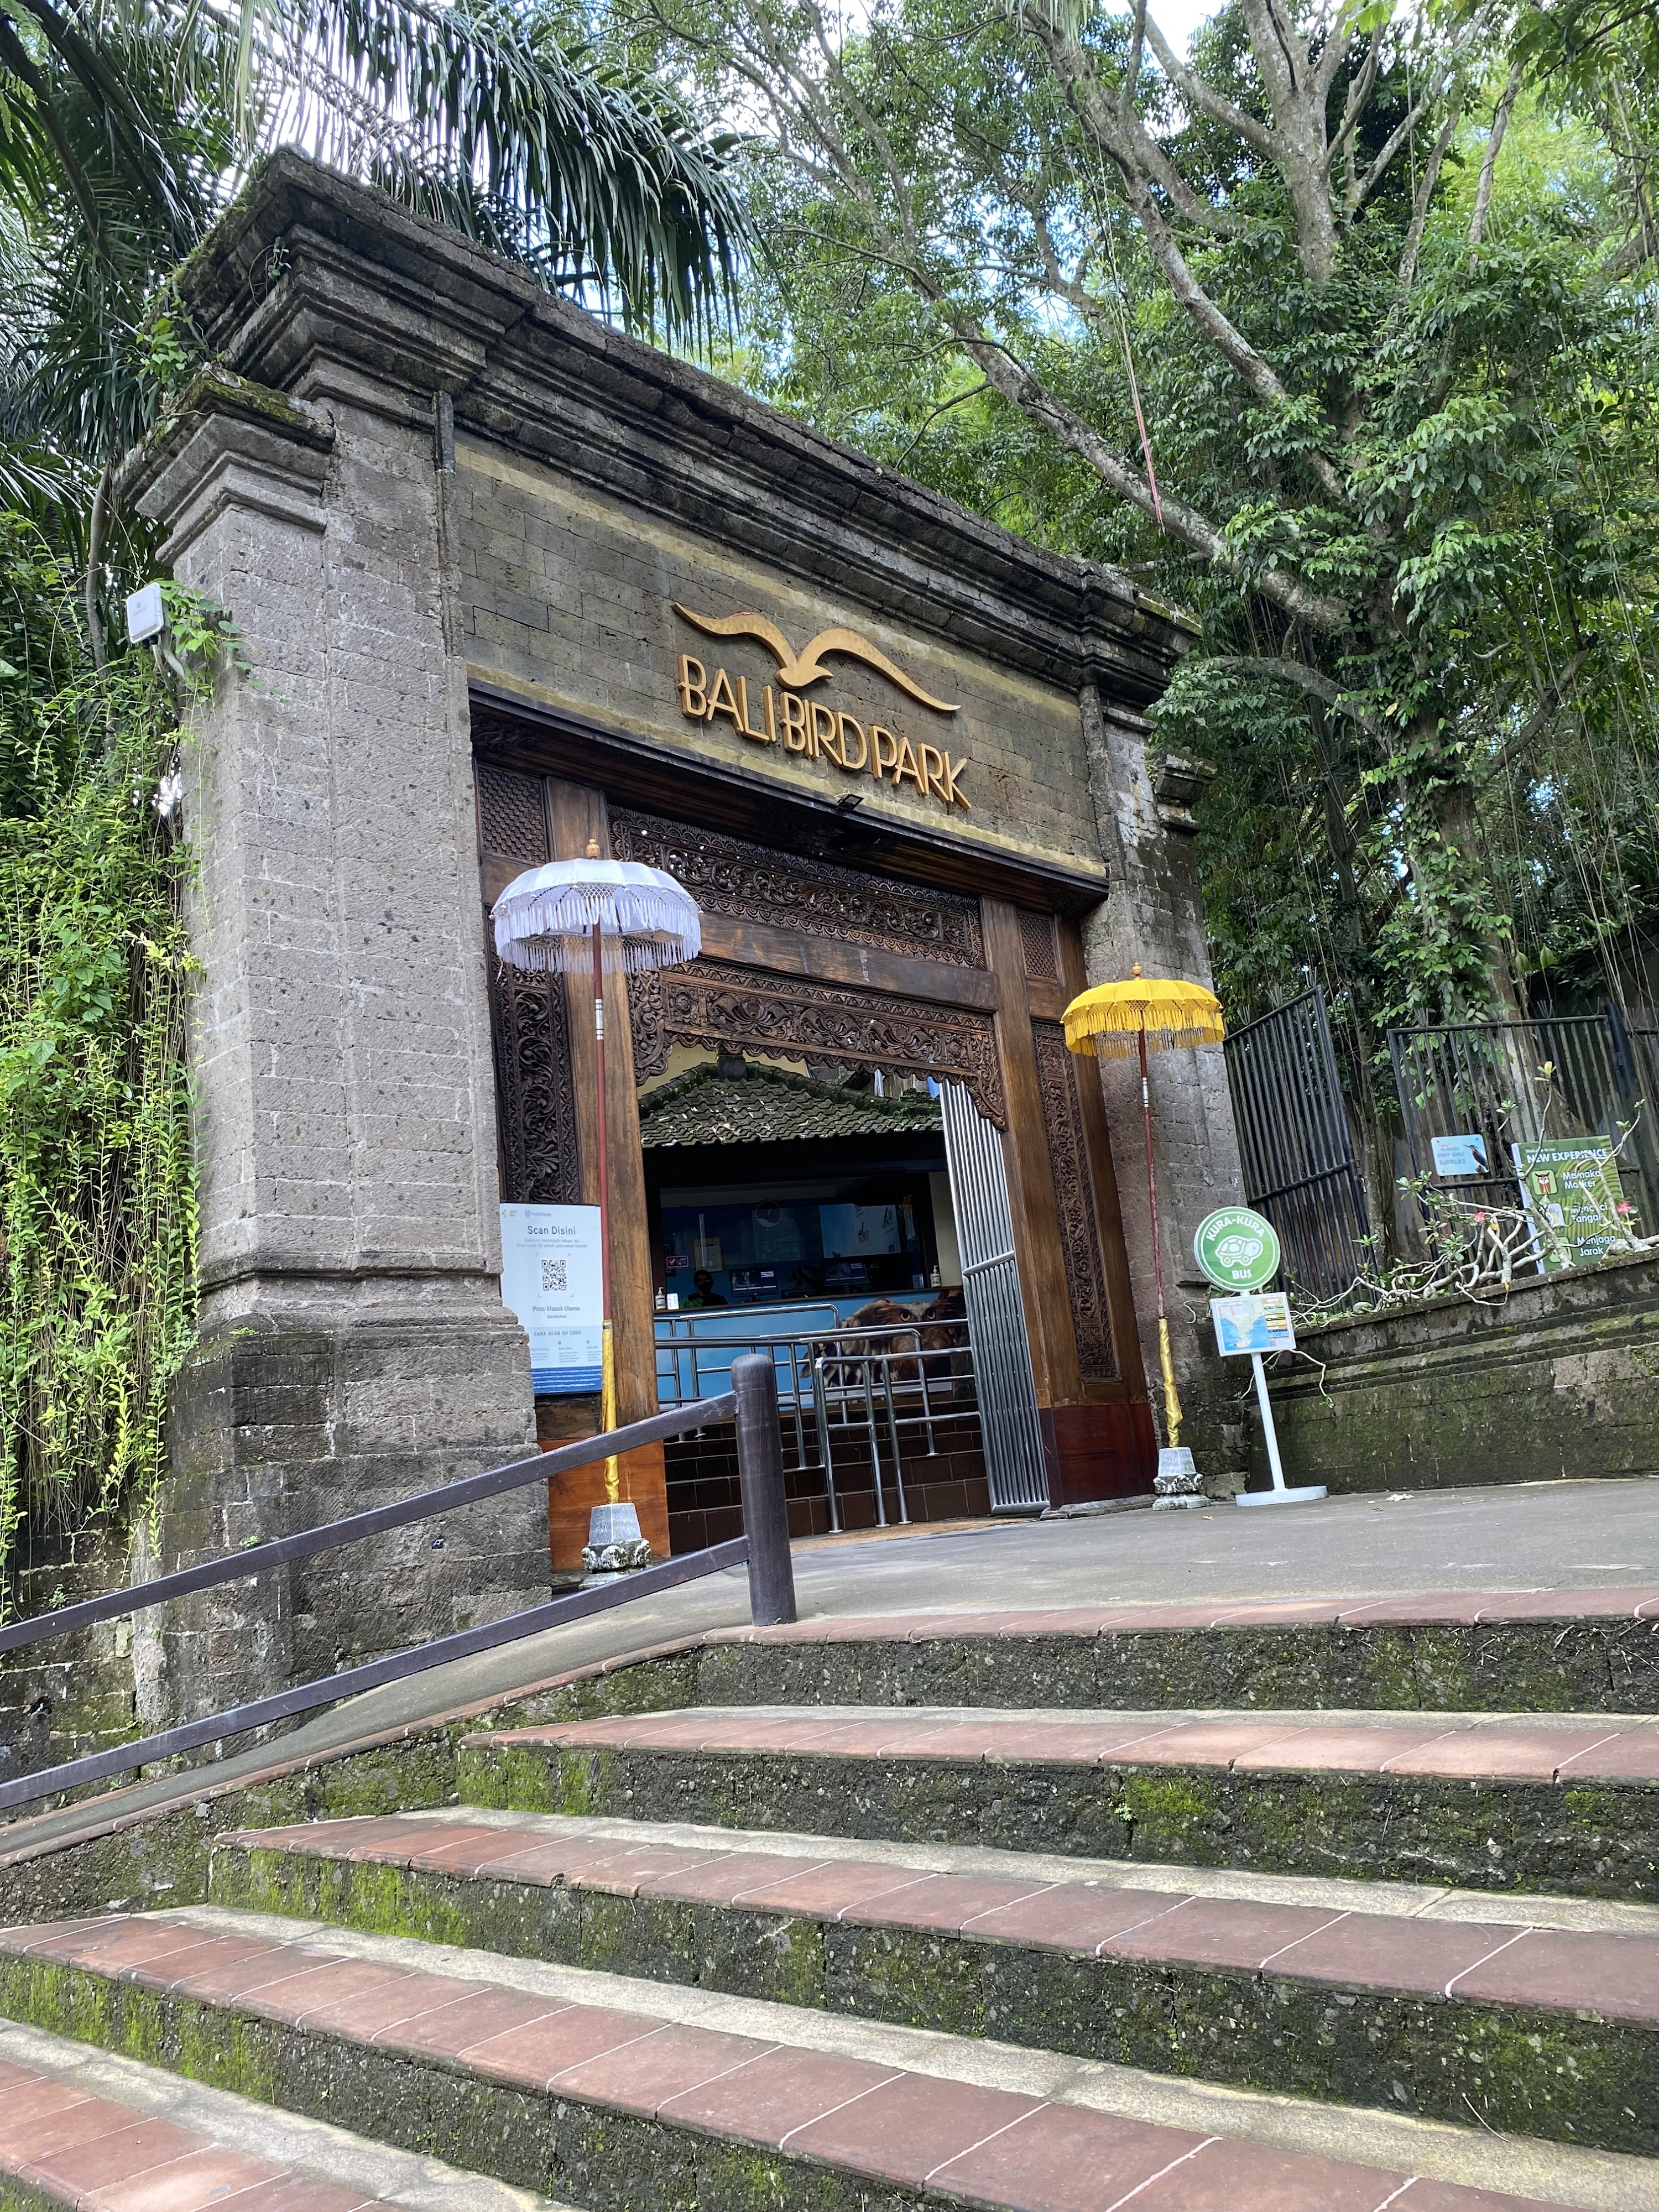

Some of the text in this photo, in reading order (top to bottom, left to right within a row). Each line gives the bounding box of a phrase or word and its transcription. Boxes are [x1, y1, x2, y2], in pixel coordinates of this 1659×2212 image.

[678, 654, 972, 810] BALI BIRD PARK
[1564, 1180, 1597, 1190] Maker
[1571, 1202, 1608, 1214] Mencci
[528, 1225, 576, 1235] Scan Disini
[1206, 1215, 1265, 1241] KURA-KURA
[1579, 1246, 1605, 1256] Jarak
[1232, 1269, 1253, 1280] BUS
